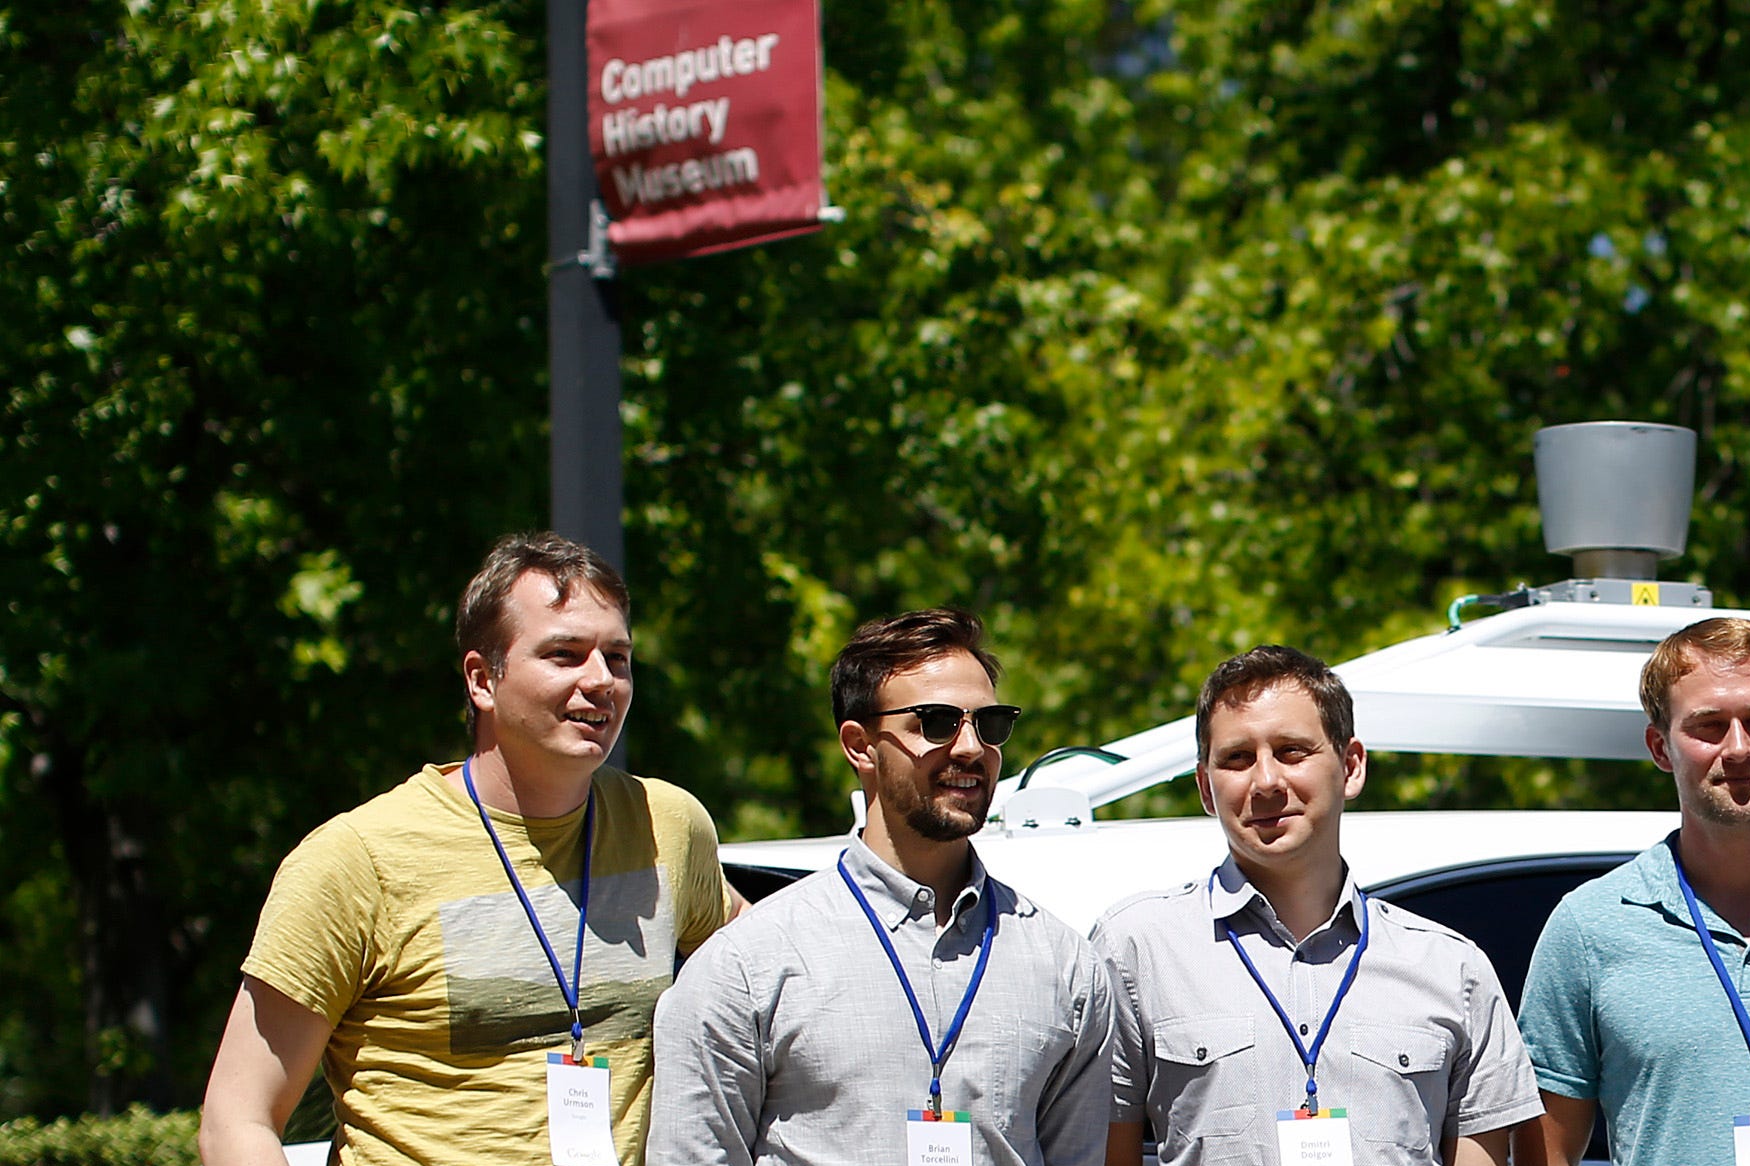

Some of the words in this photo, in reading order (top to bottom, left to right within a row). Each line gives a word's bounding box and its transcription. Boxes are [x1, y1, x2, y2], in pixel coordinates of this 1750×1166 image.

[601, 33, 779, 103] Computer
[602, 97, 729, 157] History
[612, 147, 759, 208] Museum
[568, 1088, 589, 1098] Chris
[563, 1098, 594, 1109] Urmson
[928, 1144, 951, 1153] Brian
[1300, 1139, 1331, 1149] Dmitri
[921, 1155, 960, 1164] Torcellini
